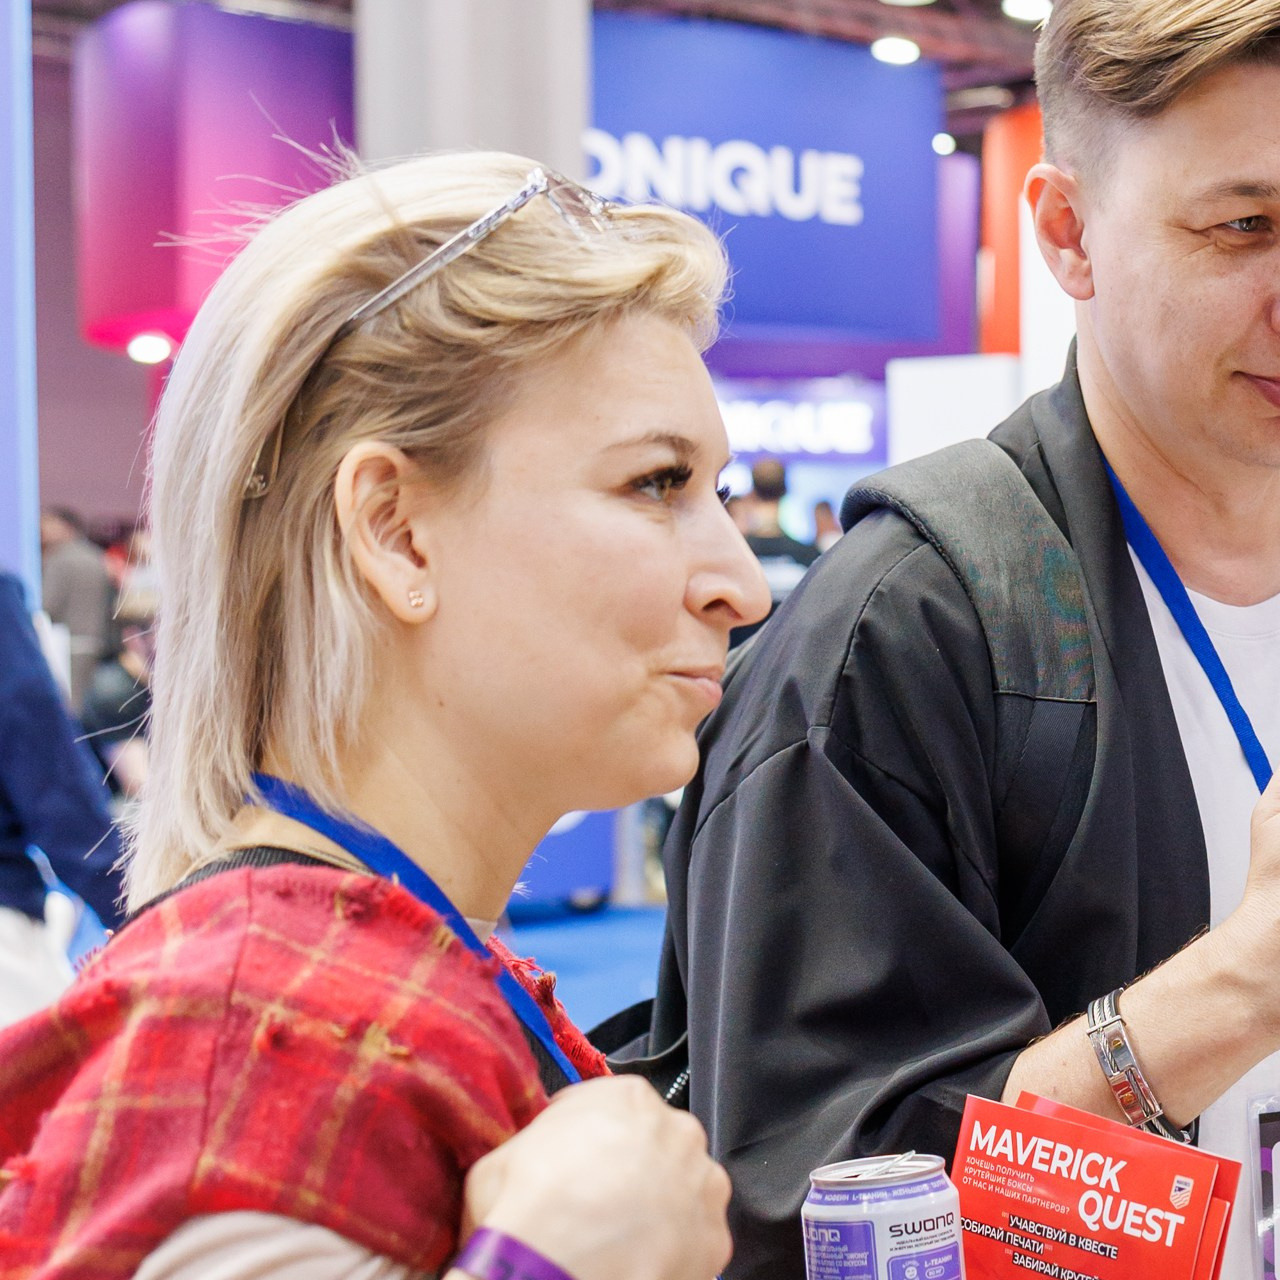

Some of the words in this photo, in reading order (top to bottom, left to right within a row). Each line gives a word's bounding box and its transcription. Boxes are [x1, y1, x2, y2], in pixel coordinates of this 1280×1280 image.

[966, 1156, 995, 1170] ХОЧЕШЬ
[996, 1164, 1035, 1183] ПОЛУЧИТЬ
[969, 1120, 1127, 1193] MAVERICK
[962, 1176, 971, 1186] ОТ
[973, 1180, 987, 1191] НАС
[988, 1184, 994, 1193] И
[994, 1186, 1021, 1200] НАШИХ
[1022, 1194, 1070, 1214] ПАРТНЕРОВ?
[964, 1166, 1006, 1186] КРУТЕЙШИЕ
[1007, 1179, 1033, 1193] БОКСЫ
[1078, 1189, 1185, 1247] QUEST
[1006, 1232, 1045, 1255] ПЕЧАТИ
[1009, 1214, 1067, 1244] УЧАВСТВУЙ
[1068, 1233, 1077, 1246] В
[1078, 1235, 1118, 1259] КВЕСТЕ
[1013, 1251, 1060, 1279] ЗАБИРАЙ
